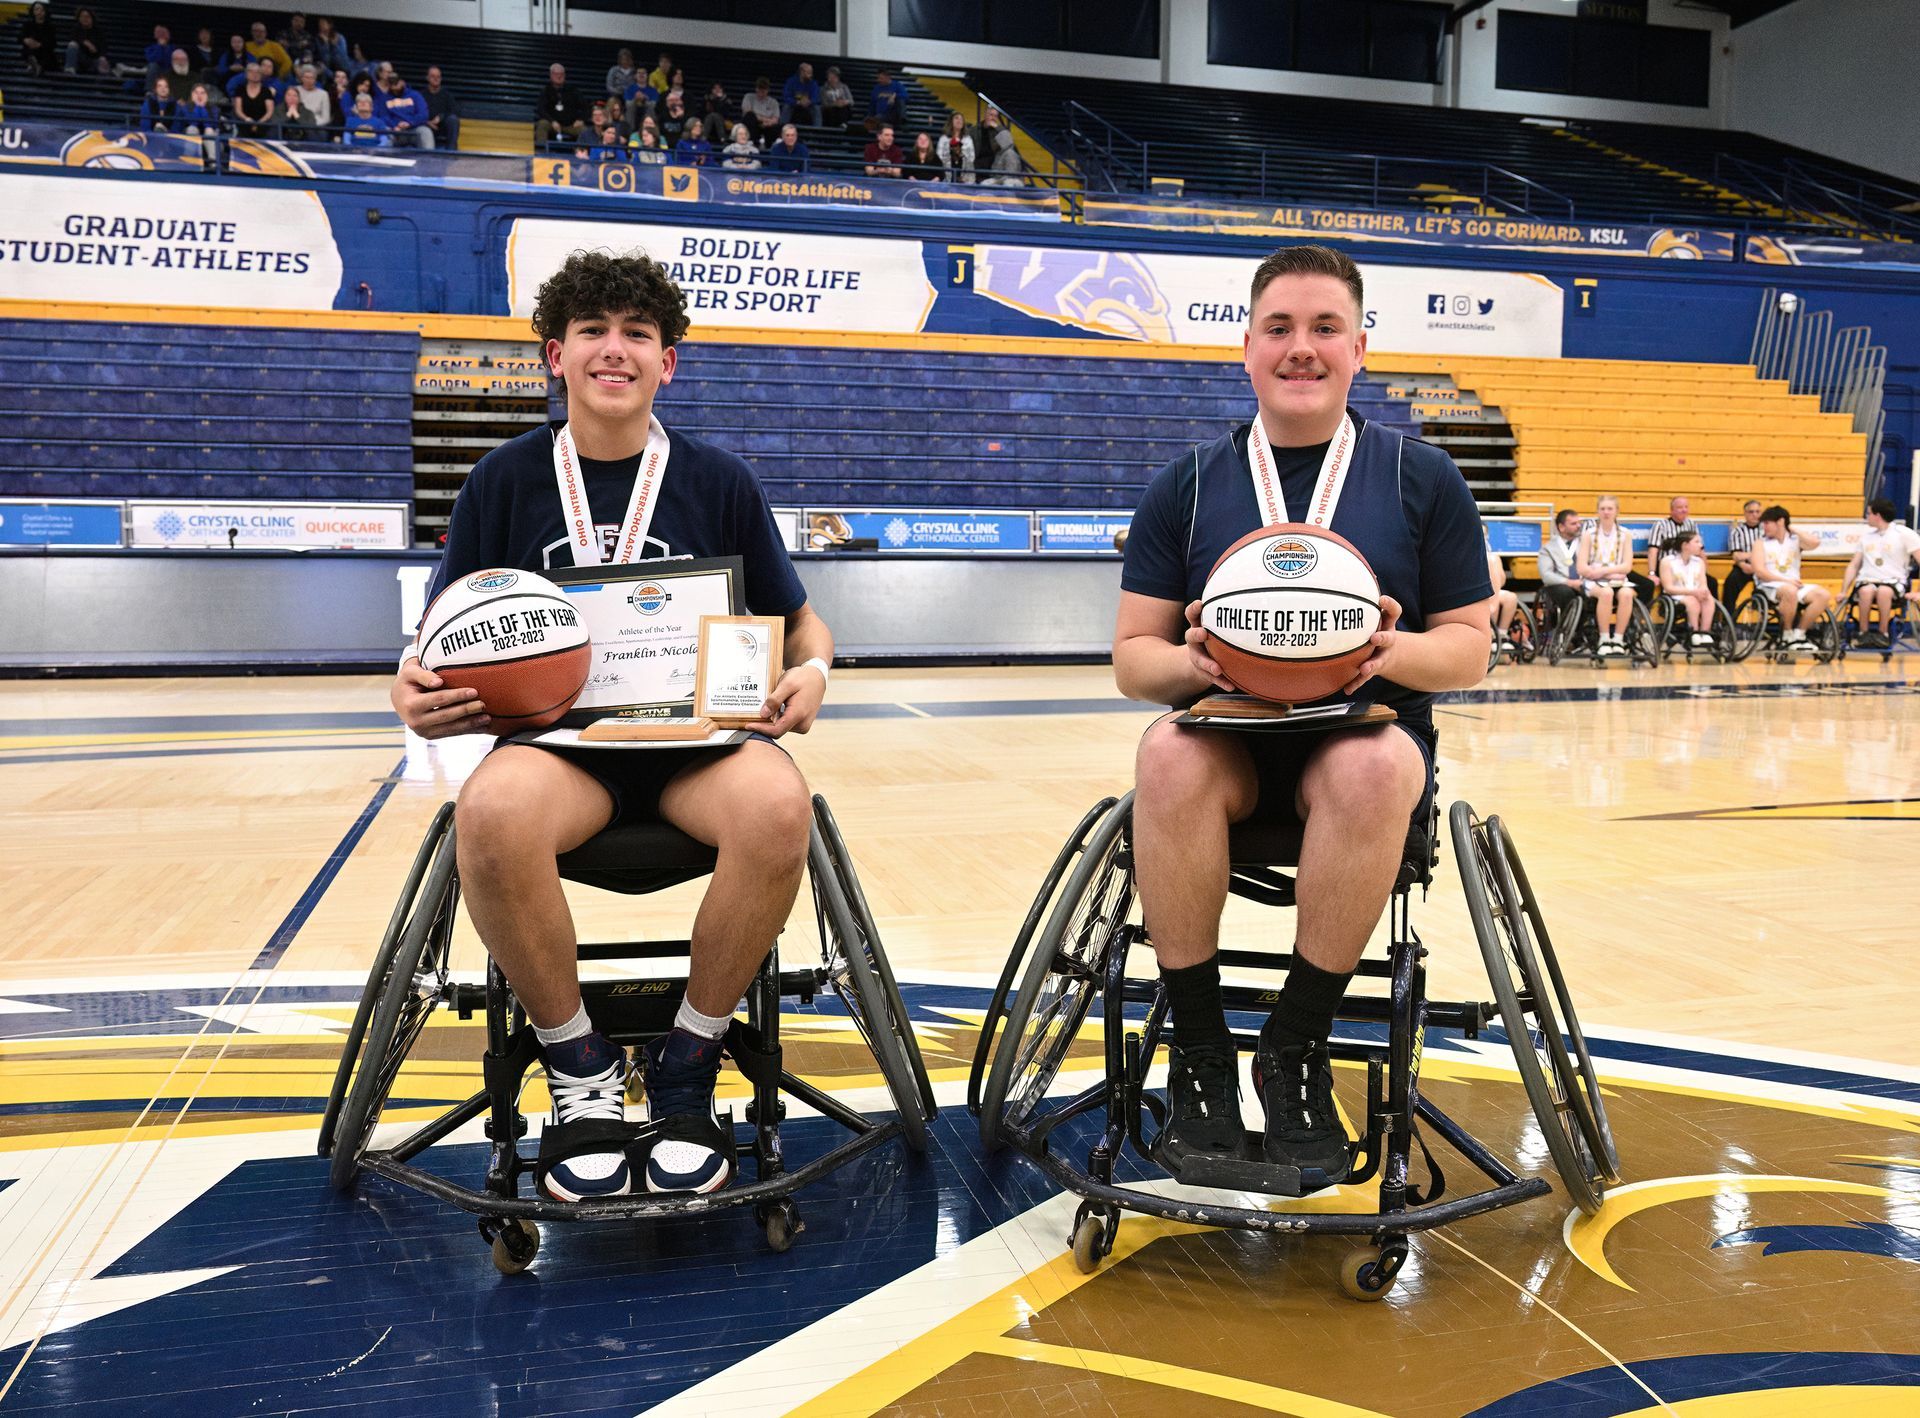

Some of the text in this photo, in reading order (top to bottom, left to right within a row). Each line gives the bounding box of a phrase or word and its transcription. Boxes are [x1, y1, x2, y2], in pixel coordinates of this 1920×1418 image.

[727, 178, 872, 200] @KentStAthletics
[64, 214, 237, 243] GRADUATE
[1271, 208, 1628, 244] ALL TOGETHER, LET'S GO FORWARD. KSU.
[680, 237, 781, 261] BOLDLY
[748, 266, 800, 288] FOR
[805, 269, 861, 290] LIFE
[953, 259, 967, 284] J
[734, 291, 822, 313] SPORT
[428, 360, 473, 368] KENT
[420, 378, 545, 390] GOLDEN FLASHES
[1252, 425, 1261, 448] OHIO
[646, 453, 659, 477] OHIO
[1318, 436, 1349, 514] INTERSCHOLASTIC
[560, 432, 588, 547] OHIO INTERSCHOLASTIC
[188, 515, 385, 534] CRYSTAL CLINIC QUICKCARE
[188, 527, 296, 538] ORTHOPDIC CENTER
[621, 480, 652, 564] INTERSCHOLASTIC
[912, 522, 1000, 534] CRYSTAL CLINIC
[1046, 523, 1107, 535] NATIONALLY
[912, 534, 1000, 543] ORTHOPAEDIC CENTER
[1266, 552, 1315, 560] CHAMPIONSHIP
[618, 624, 682, 637] Athlete of the Year
[1216, 607, 1364, 632] ATHLETE OF THE YEAR
[440, 608, 579, 657] ATHLETE OF THE YEAR
[491, 629, 546, 652] 2022-2023
[1260, 632, 1317, 647] 2022-2023
[603, 647, 657, 664] Franklin
[741, 683, 758, 691] YEAR
[617, 707, 671, 717] ADAPTIVE
[611, 982, 671, 994] TOP END
